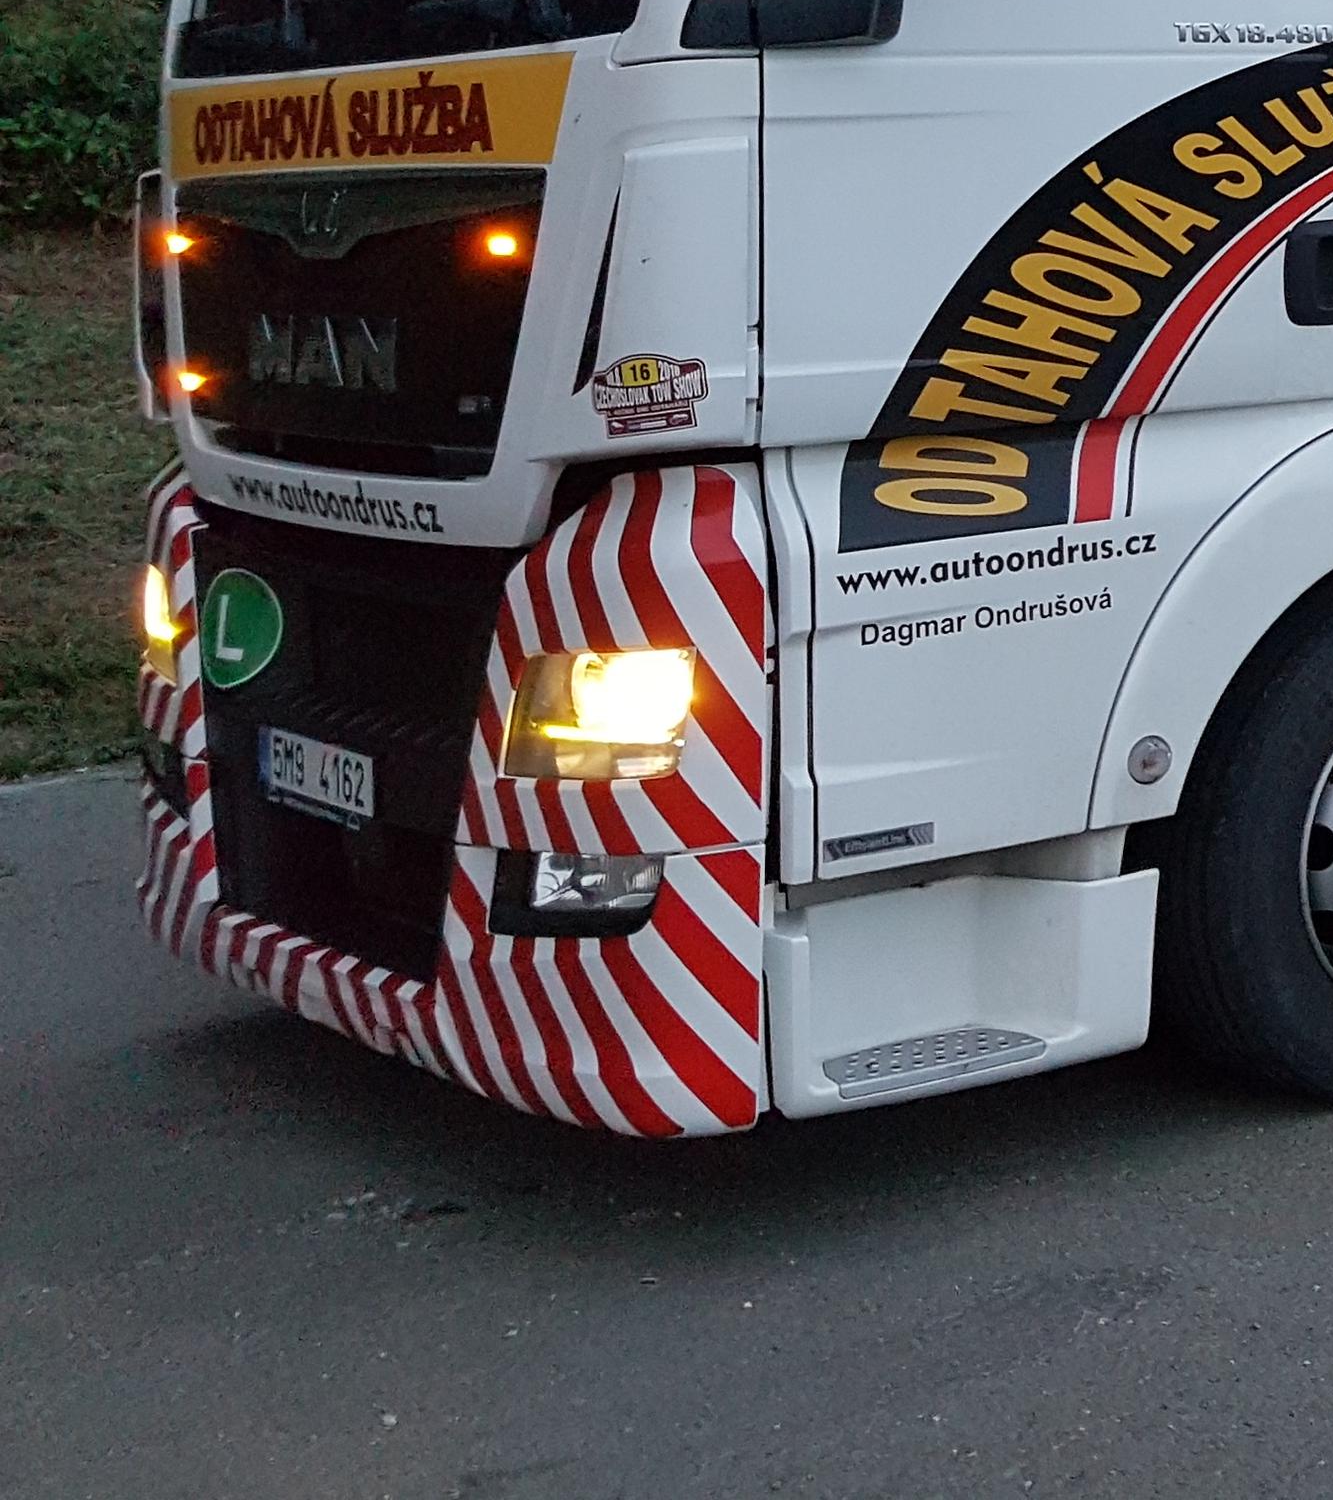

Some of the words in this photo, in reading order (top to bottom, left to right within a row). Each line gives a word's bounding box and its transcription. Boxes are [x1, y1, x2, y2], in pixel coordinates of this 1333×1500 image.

[1174, 22, 1231, 43] TGX
[1235, 23, 1333, 43] 18.480
[196, 78, 340, 164] ODTAHOVÁ
[349, 71, 494, 157] SLUŽBA
[250, 314, 398, 389] MAN
[874, 161, 1220, 516] ODTAHOVÁ
[629, 363, 651, 382] 16
[650, 381, 672, 403] TOW
[673, 369, 702, 400] SHOW
[228, 474, 444, 532] www.autoondrus.cz
[837, 531, 1157, 595] www.autoondrus.cz
[215, 594, 245, 660] L
[861, 615, 966, 646] Dagmar
[975, 588, 1112, 629] Ondrušová
[273, 735, 304, 786] 5M9
[320, 752, 364, 807] 4162
